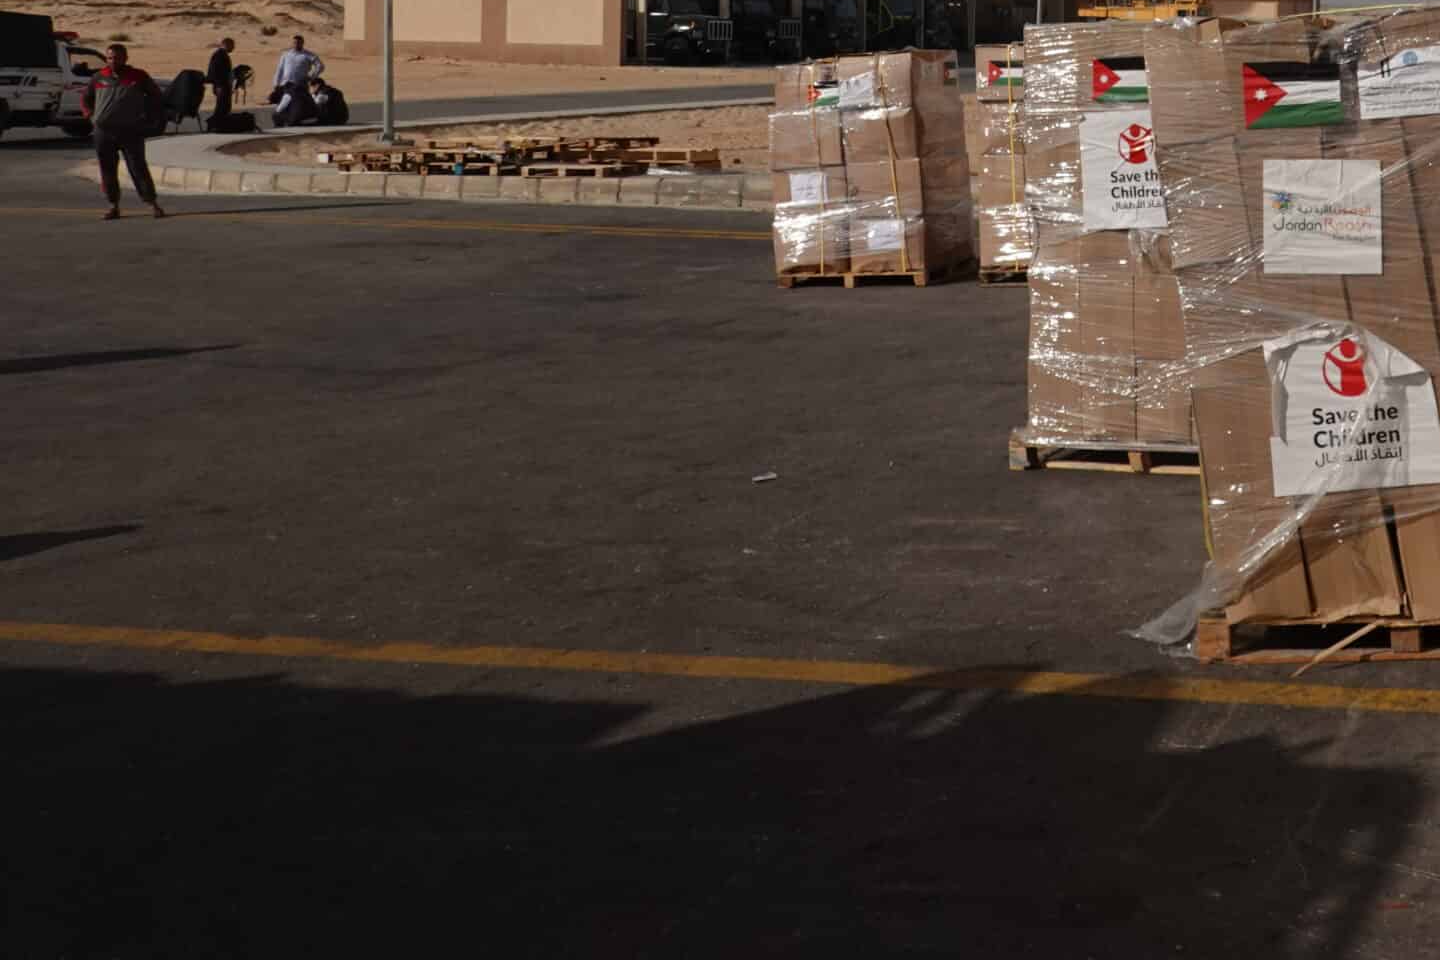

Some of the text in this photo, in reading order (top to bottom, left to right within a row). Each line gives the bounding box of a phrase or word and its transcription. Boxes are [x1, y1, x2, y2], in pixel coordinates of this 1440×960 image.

[1110, 169, 1159, 183] Save th
[1312, 407, 1359, 425] Save
